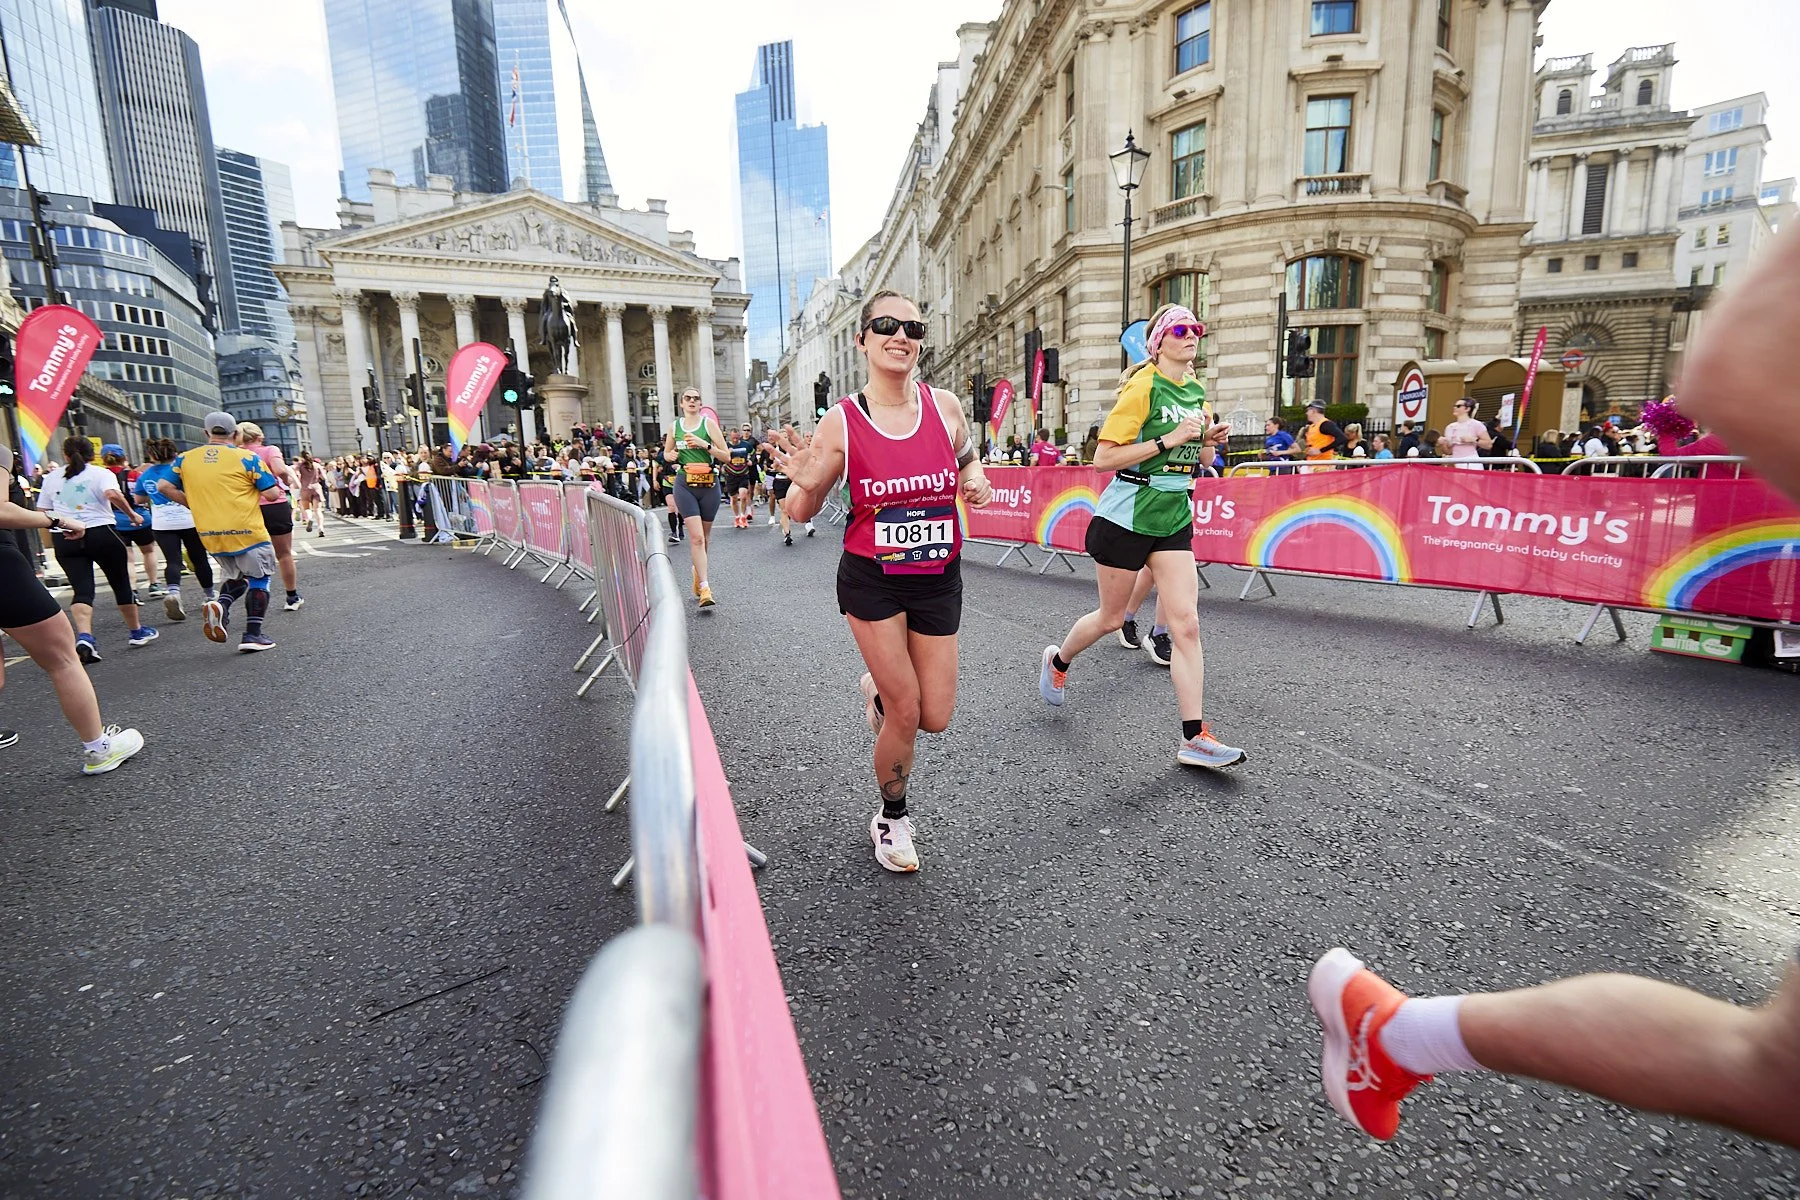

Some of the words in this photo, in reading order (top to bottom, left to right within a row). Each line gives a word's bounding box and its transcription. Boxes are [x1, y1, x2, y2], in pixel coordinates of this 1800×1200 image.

[29, 325, 77, 393] Tommy's
[455, 355, 490, 404] Tommy's
[692, 474, 710, 482] 5294
[860, 468, 956, 497] Tommy's
[882, 523, 945, 544] 10811
[1205, 528, 1234, 538] charity
[1427, 495, 1630, 546] Tommy's
[1423, 535, 1441, 546] The
[1443, 539, 1503, 553] pregnancy
[1507, 544, 1529, 555] and
[1533, 546, 1568, 561] baby
[1572, 550, 1623, 568] charity
